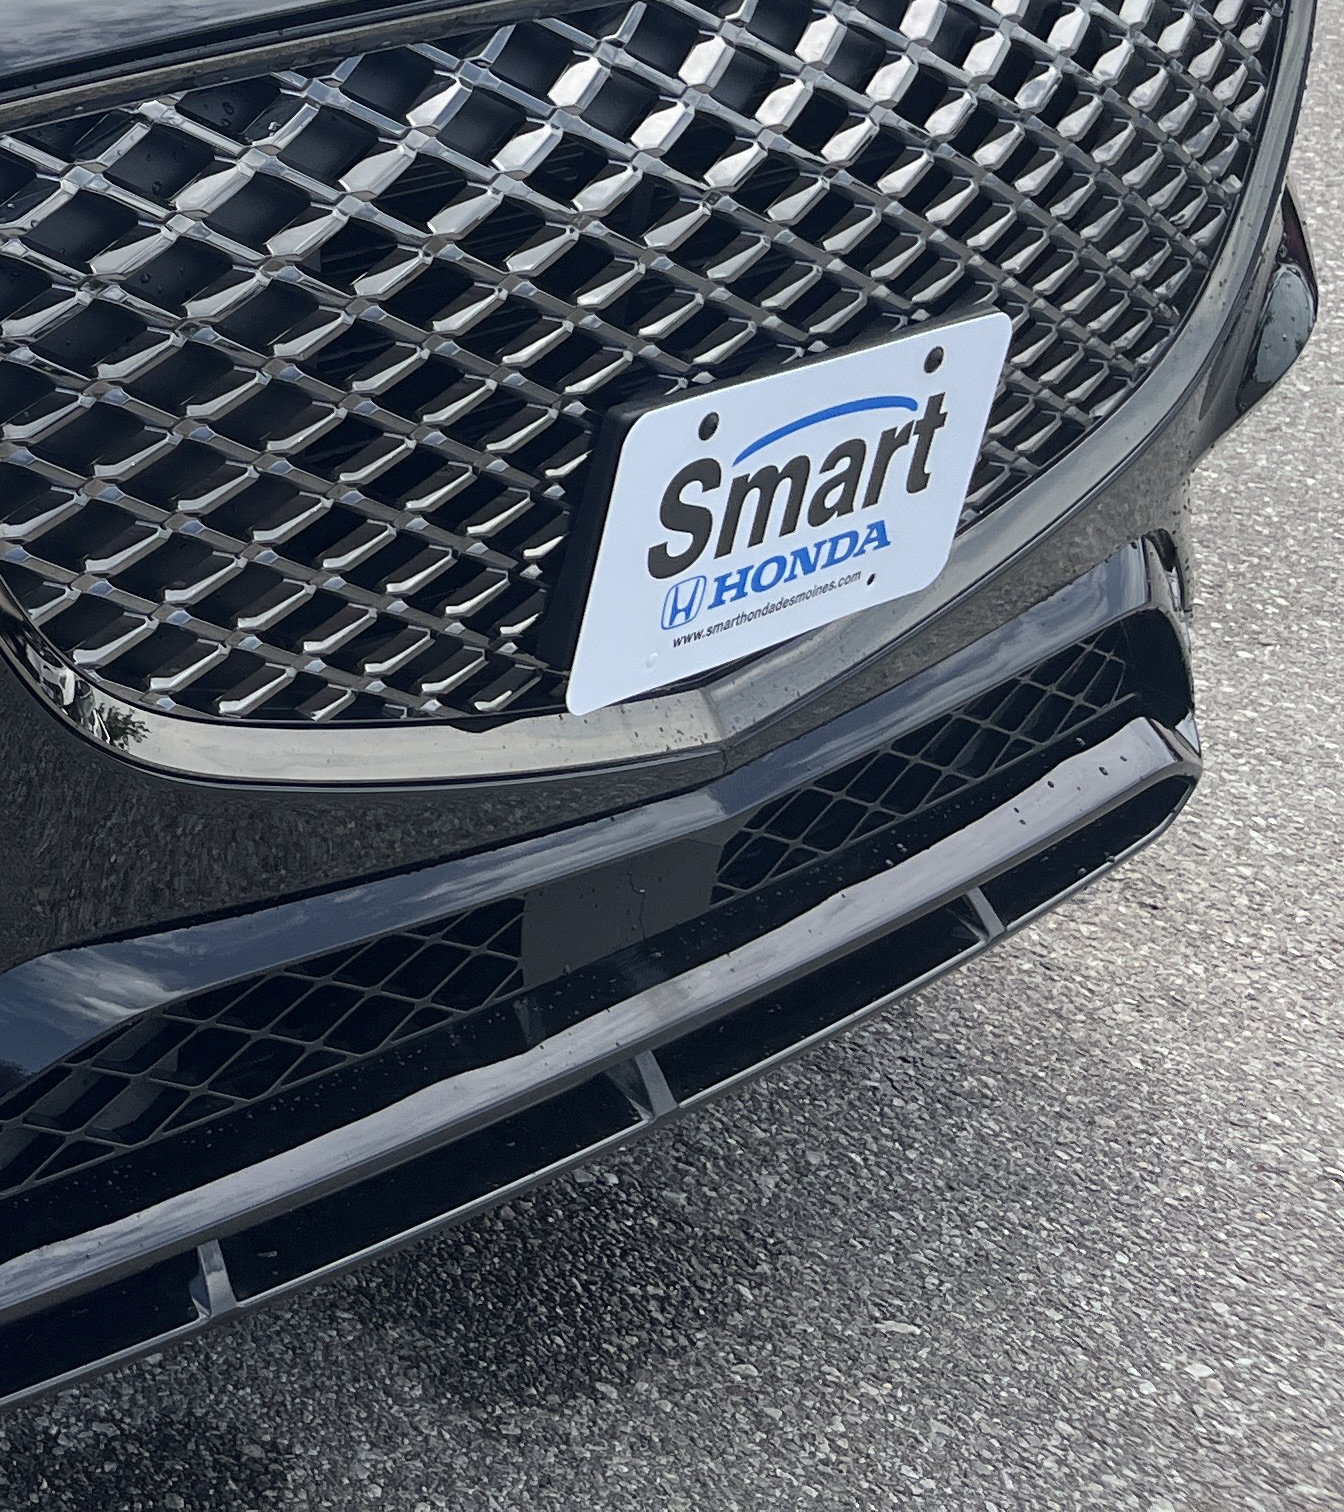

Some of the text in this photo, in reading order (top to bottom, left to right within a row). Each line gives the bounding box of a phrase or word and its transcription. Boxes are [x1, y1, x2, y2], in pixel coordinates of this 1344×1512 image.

[647, 392, 948, 579] Smart
[673, 570, 862, 648] www.smarthondadesmoines.com
[707, 519, 892, 609] HONDA
